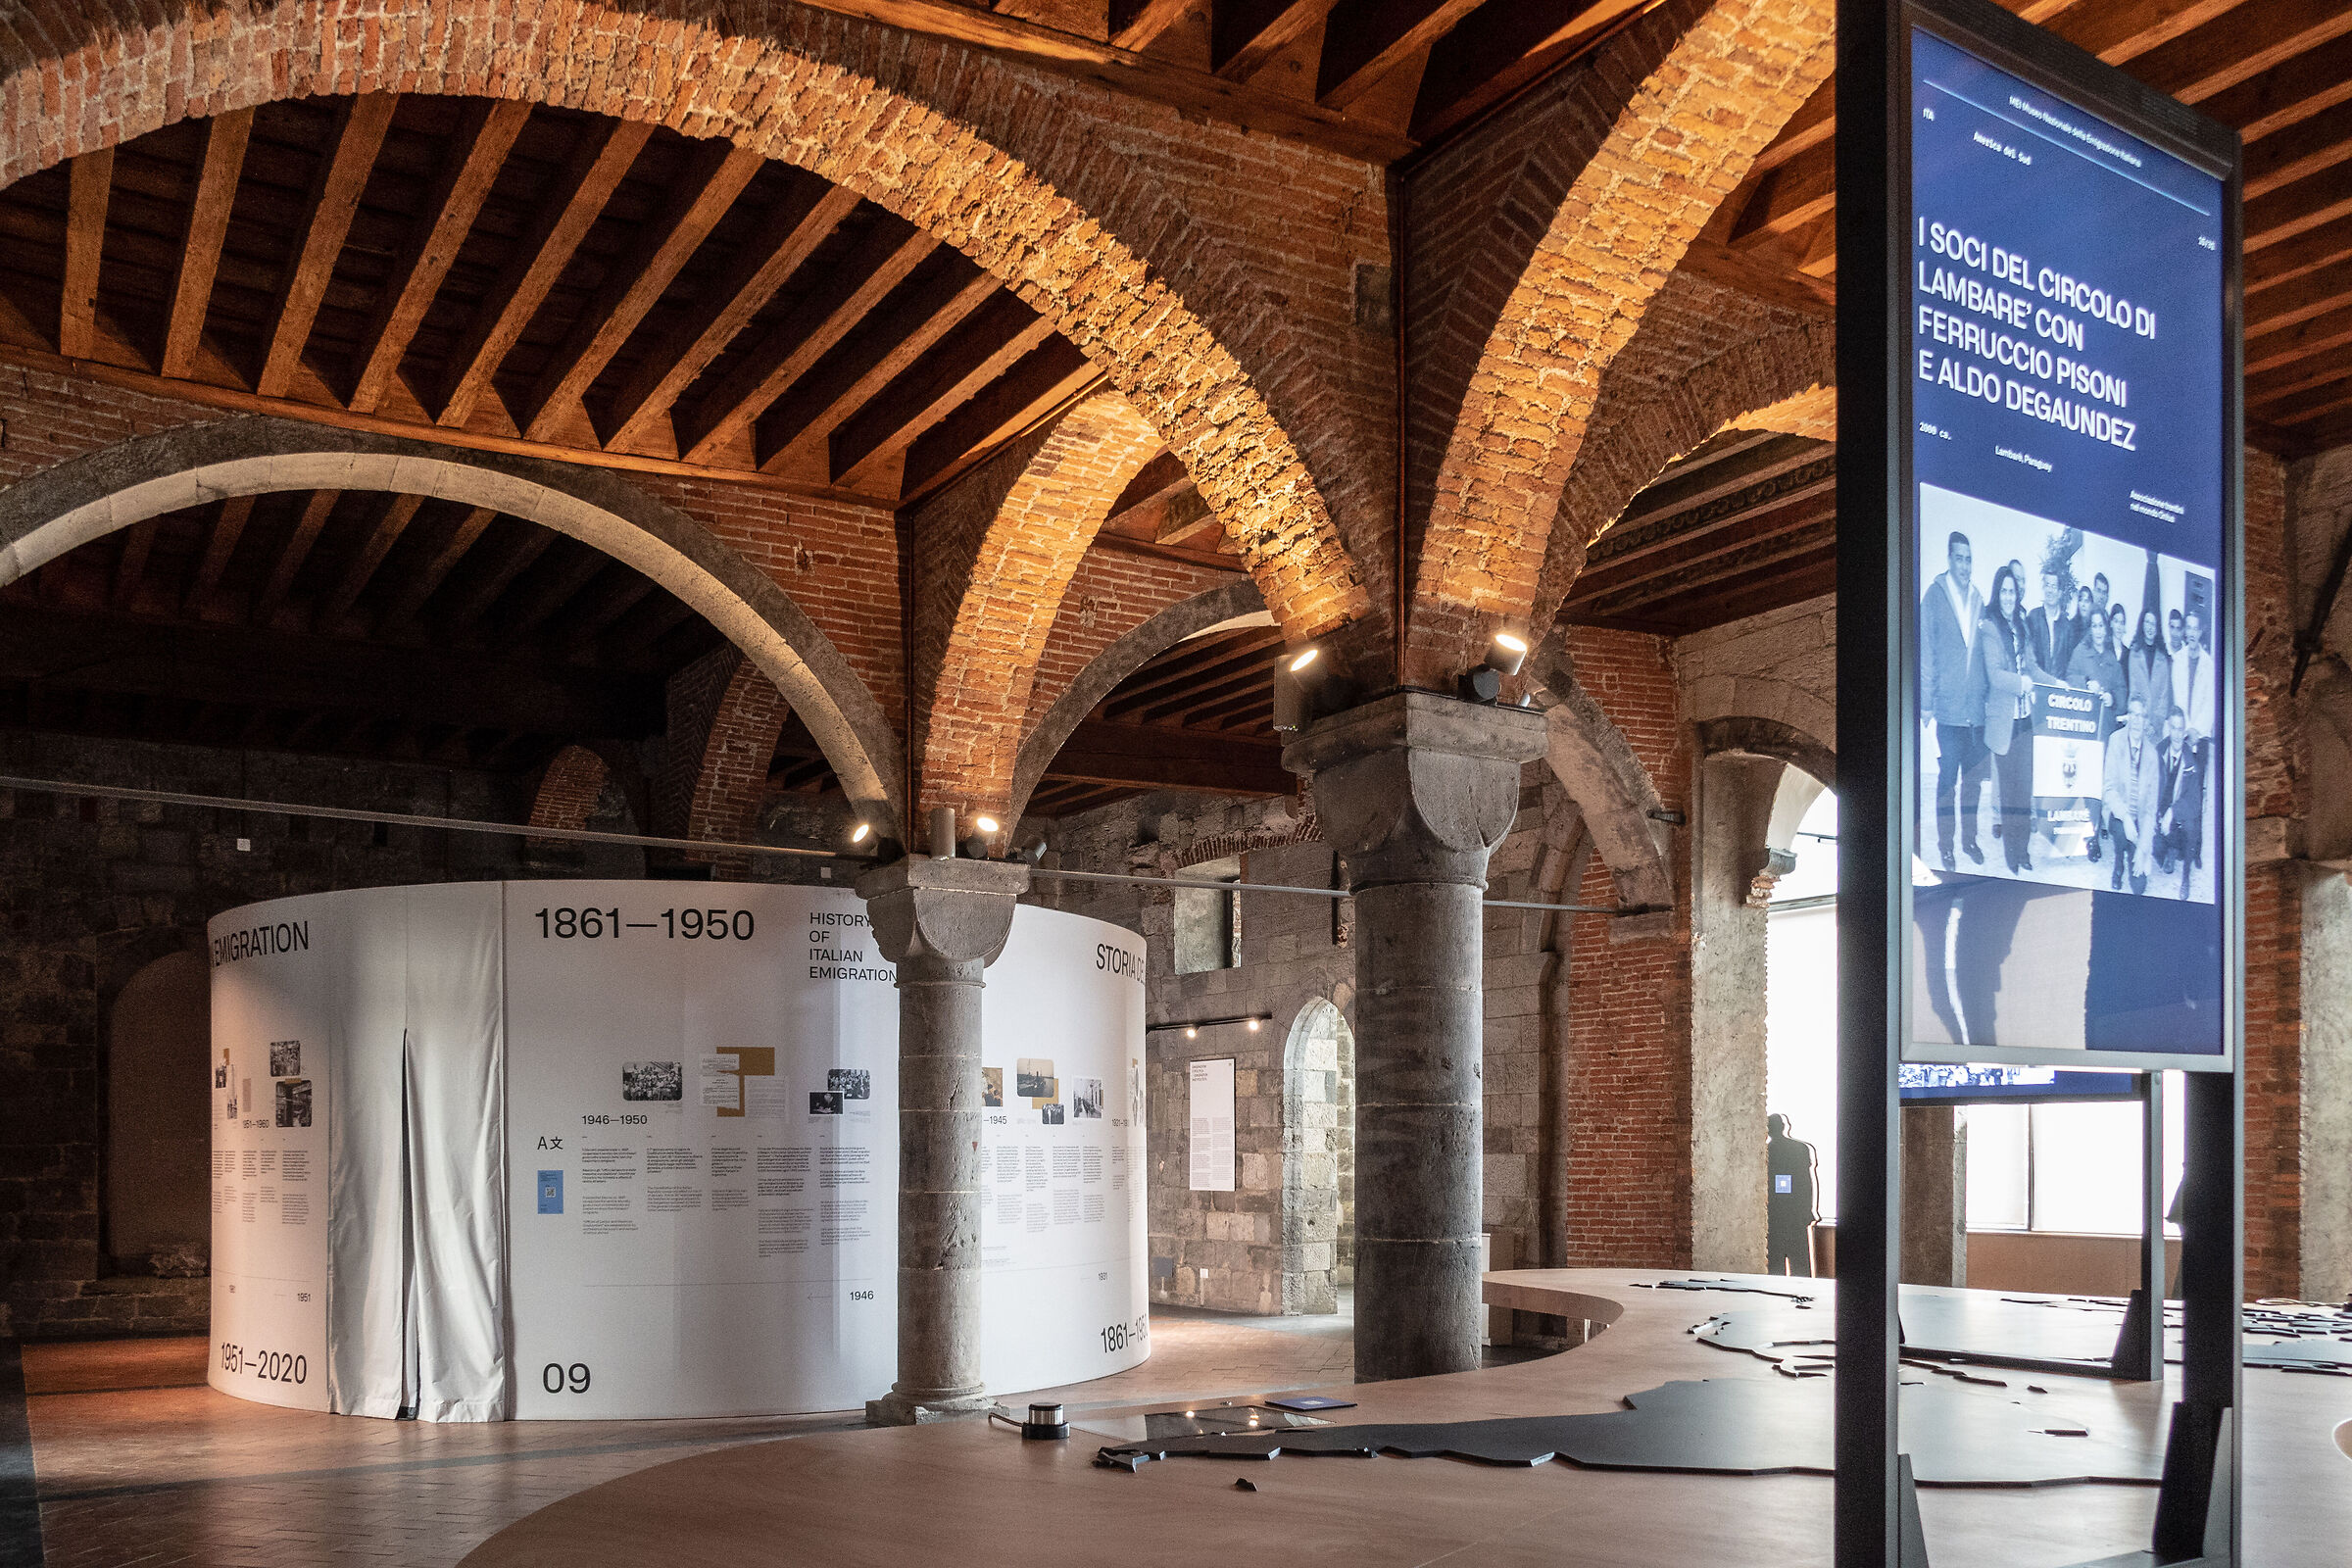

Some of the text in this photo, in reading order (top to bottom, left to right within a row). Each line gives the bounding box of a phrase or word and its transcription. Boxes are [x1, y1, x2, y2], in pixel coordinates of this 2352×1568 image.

[1918, 216, 2156, 340] I SOCI DEL CIRCOLO DI
[2034, 308, 2083, 351] CON
[1919, 305, 2127, 408] FERRUCCIO PISONI
[1919, 349, 2136, 452] E ALDO DEGAUNDEZ
[2047, 693, 2093, 712] CIRCOLO
[2046, 715, 2097, 734] TRENTINO
[215, 920, 309, 967] EMIGRATION
[808, 930, 830, 943] OF
[809, 948, 863, 962] ITALIAN
[1097, 943, 1136, 979] STORIA
[809, 966, 897, 982] EMIGRATION
[297, 1293, 311, 1302] 1951
[850, 1290, 874, 1301] 1946
[543, 1362, 591, 1394] 09
